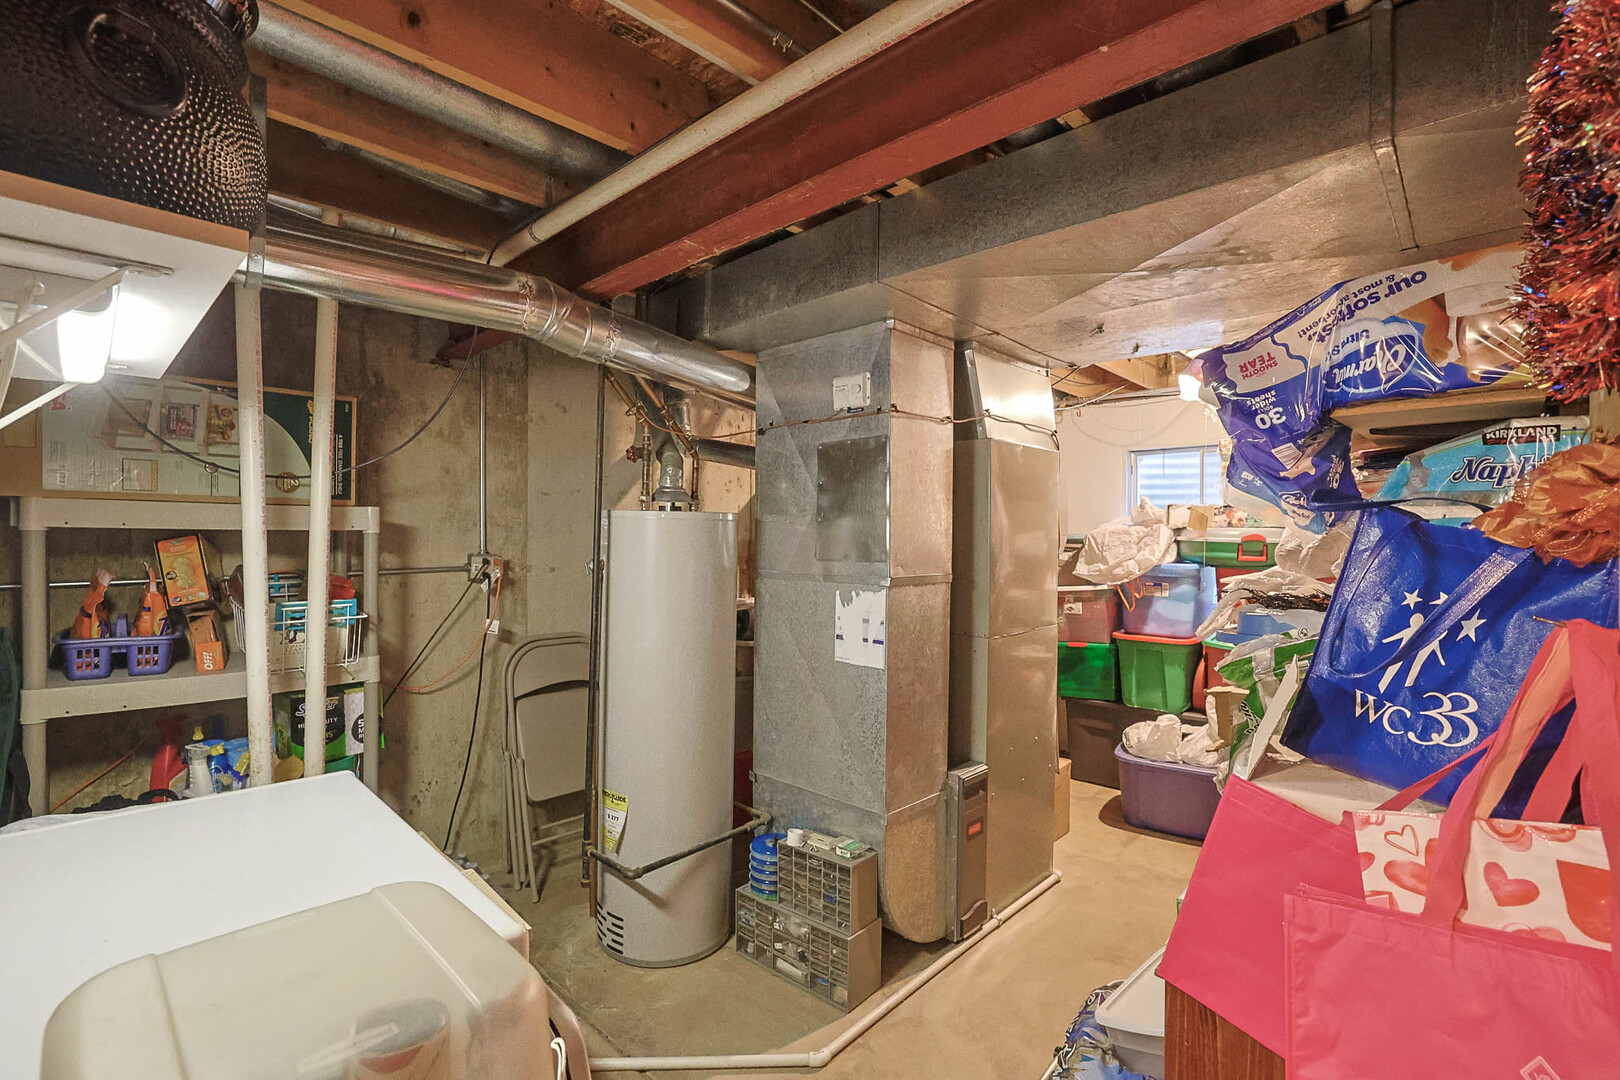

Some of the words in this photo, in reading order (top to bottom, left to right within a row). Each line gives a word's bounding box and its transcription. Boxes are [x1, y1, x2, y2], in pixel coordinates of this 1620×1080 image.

[1352, 280, 1382, 298] most
[1384, 271, 1427, 299] our
[1341, 328, 1370, 350] Ultra
[1239, 352, 1276, 374] TEAR
[1242, 360, 1279, 380] SMOOTH
[1331, 341, 1407, 386] Charmin
[1246, 389, 1277, 407] sheets
[1251, 396, 1277, 412] wider
[1254, 406, 1287, 430] 30
[1486, 426, 1558, 440] KIRKLAND
[202, 651, 214, 671] OFF!
